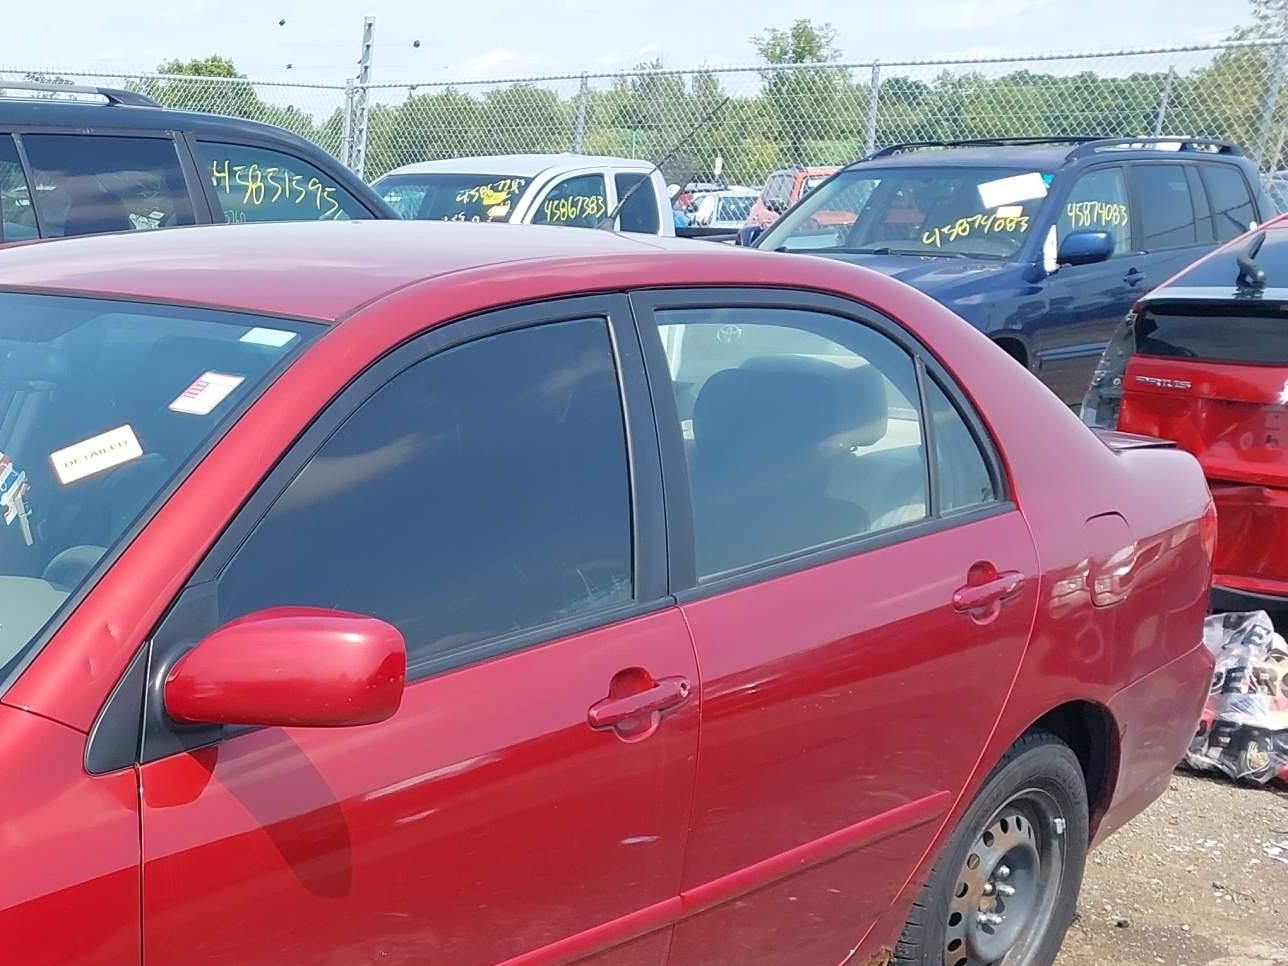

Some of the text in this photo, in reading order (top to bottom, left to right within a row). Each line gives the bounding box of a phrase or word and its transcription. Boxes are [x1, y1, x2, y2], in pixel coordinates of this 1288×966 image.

[543, 195, 606, 222] 45867383
[1066, 201, 1129, 229] 45874083
[922, 213, 1031, 248] 45874083
[1135, 375, 1193, 389] PRIUS
[64, 439, 128, 468] DETAILED
